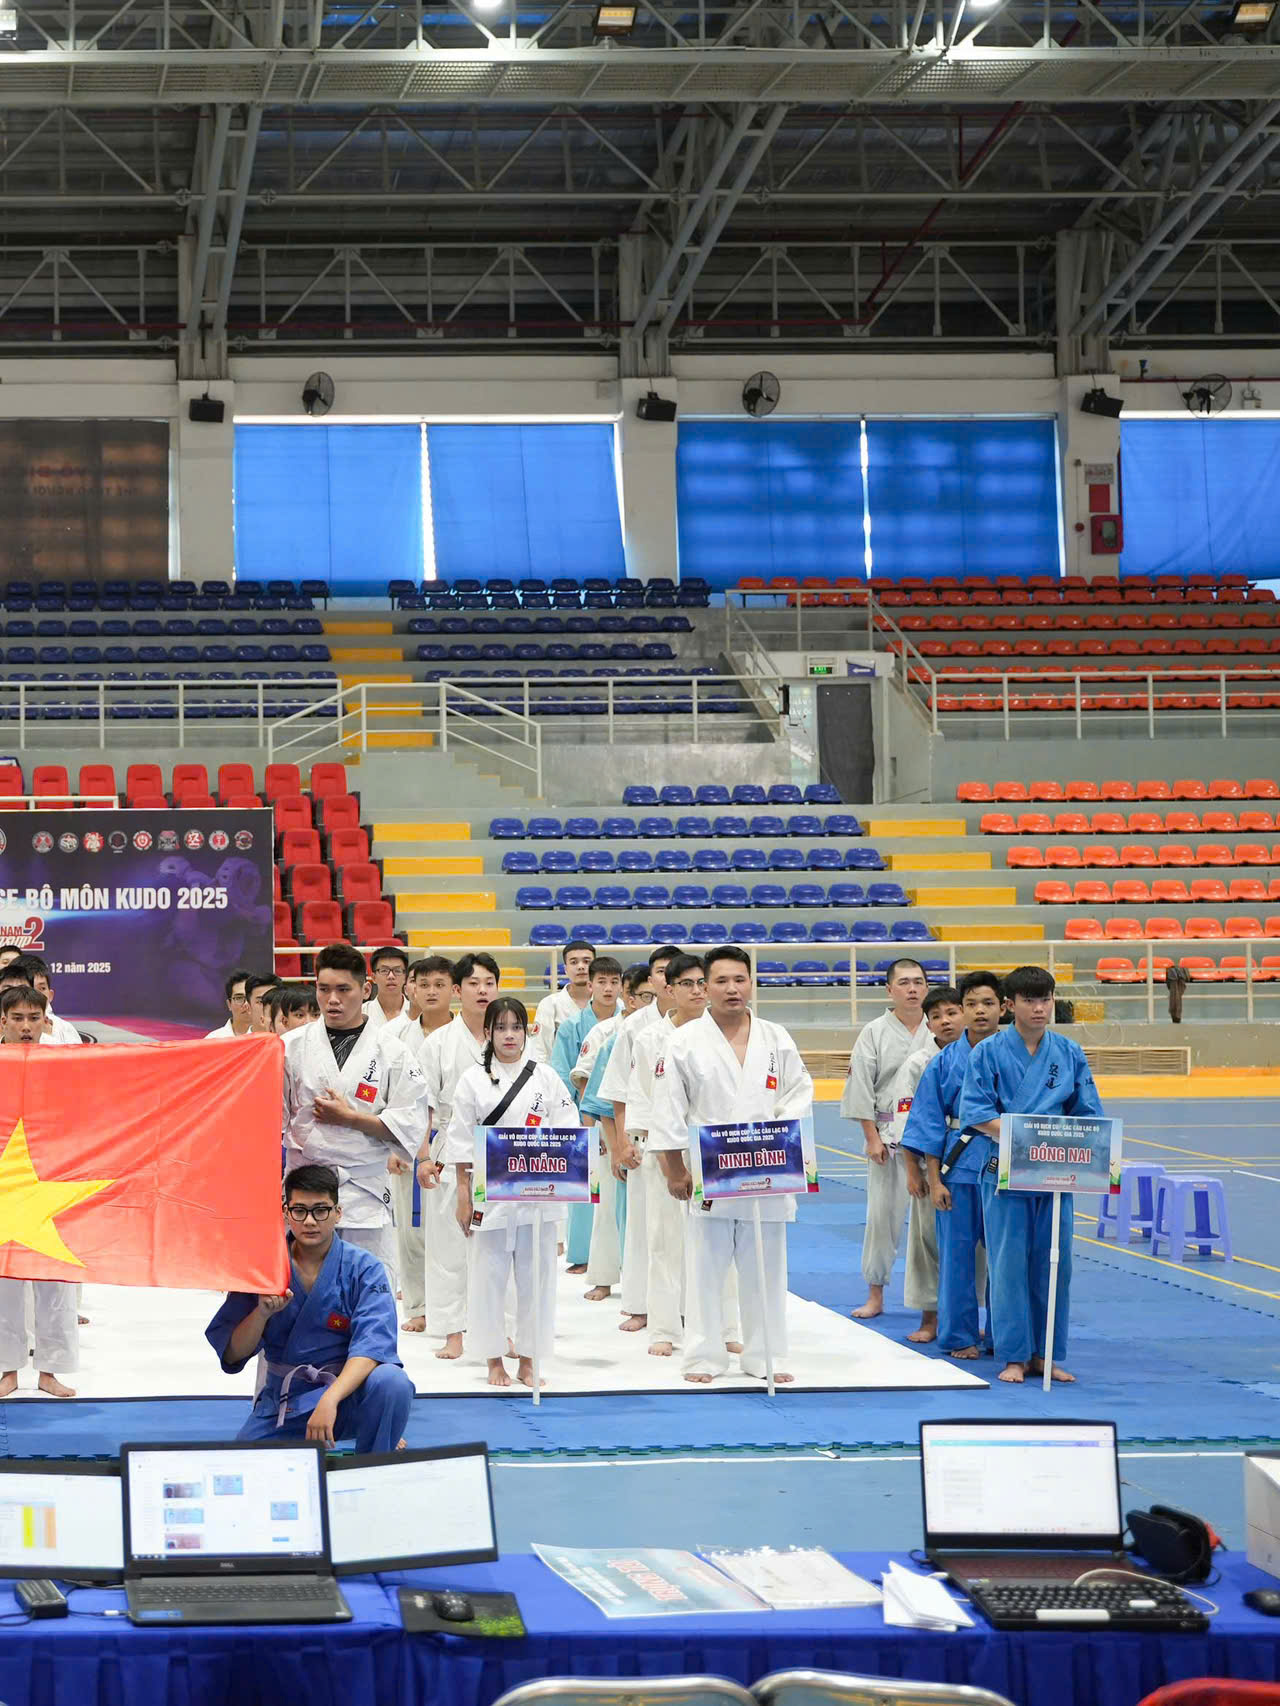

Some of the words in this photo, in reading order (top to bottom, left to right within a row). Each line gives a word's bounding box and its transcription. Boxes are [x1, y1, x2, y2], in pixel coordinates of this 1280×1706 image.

[60, 883, 109, 910] MÔN
[116, 887, 170, 910] KUDO
[177, 887, 228, 909] 2025
[24, 917, 44, 949] 2
[50, 963, 63, 973] 12
[64, 961, 85, 973] năm
[87, 962, 111, 973] 2025
[508, 1154, 527, 1172] ĐÀ
[530, 1152, 567, 1173] NẴNG
[718, 1152, 753, 1169] NINH
[755, 1148, 787, 1167] BÌNH
[1067, 1147, 1091, 1164] NAI
